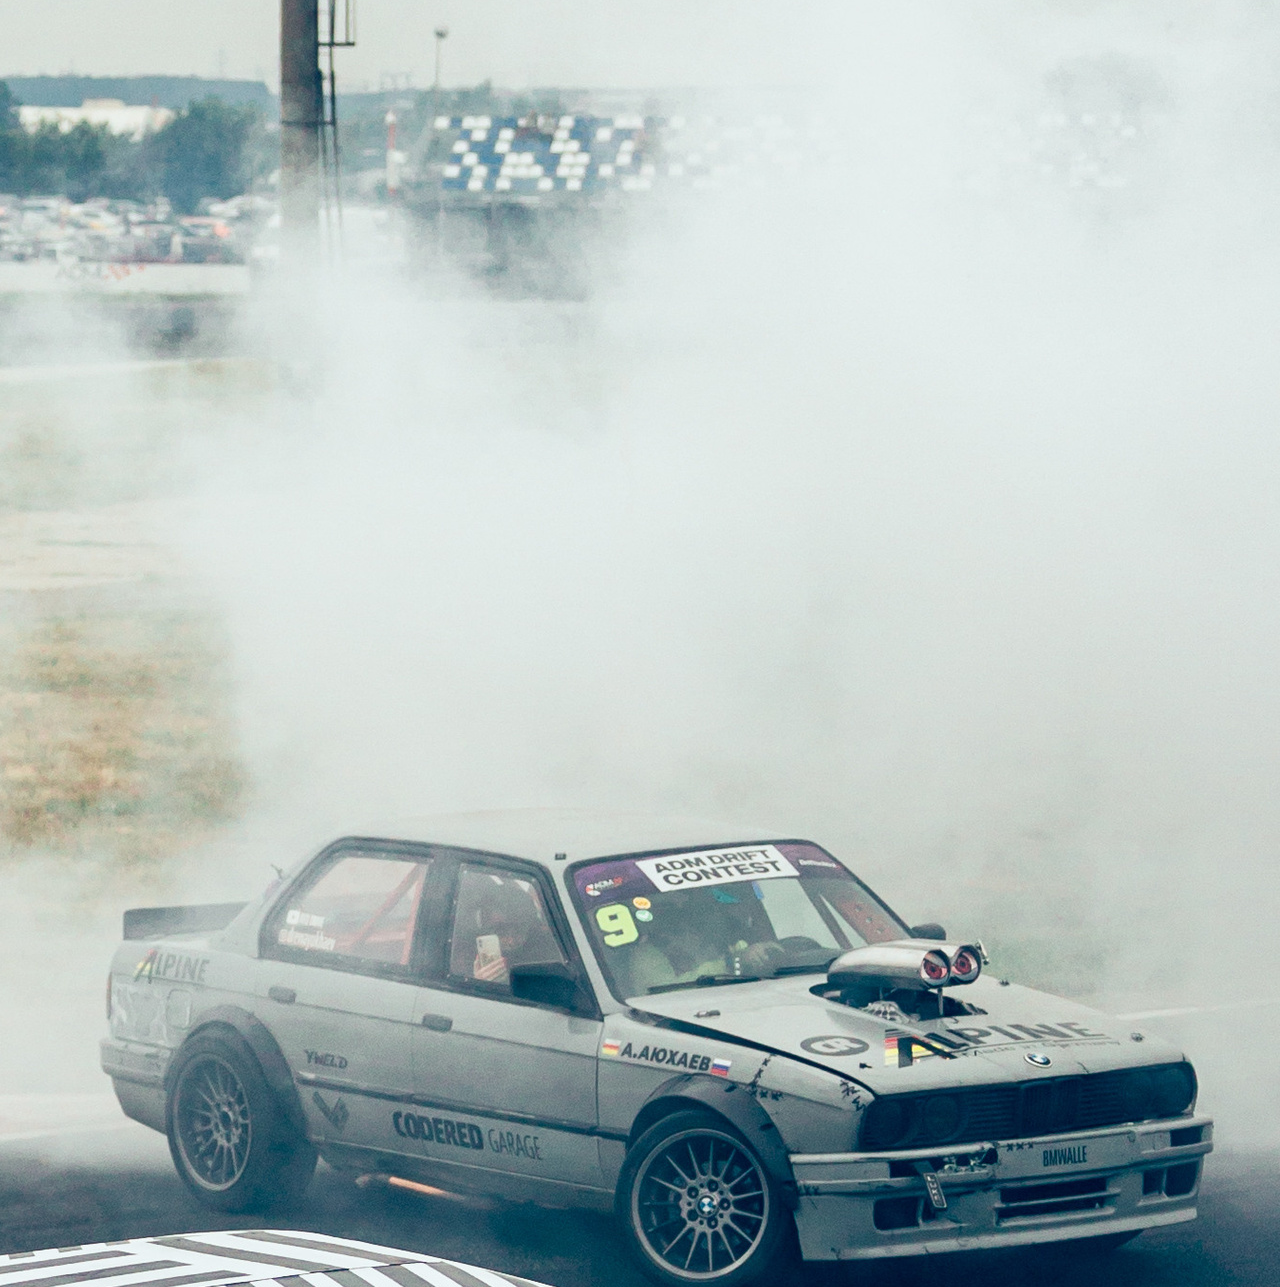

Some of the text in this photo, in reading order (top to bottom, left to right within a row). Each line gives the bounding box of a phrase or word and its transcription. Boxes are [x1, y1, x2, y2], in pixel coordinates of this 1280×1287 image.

[656, 850, 771, 873] ADM DRIFT
[663, 861, 781, 885] CONTEST
[596, 904, 639, 947] 9
[133, 949, 210, 984] ALPINE
[897, 1023, 1105, 1068] ALPINE
[392, 1111, 543, 1160] CODERED GARAGE
[1043, 1145, 1087, 1167] BMWALLE
